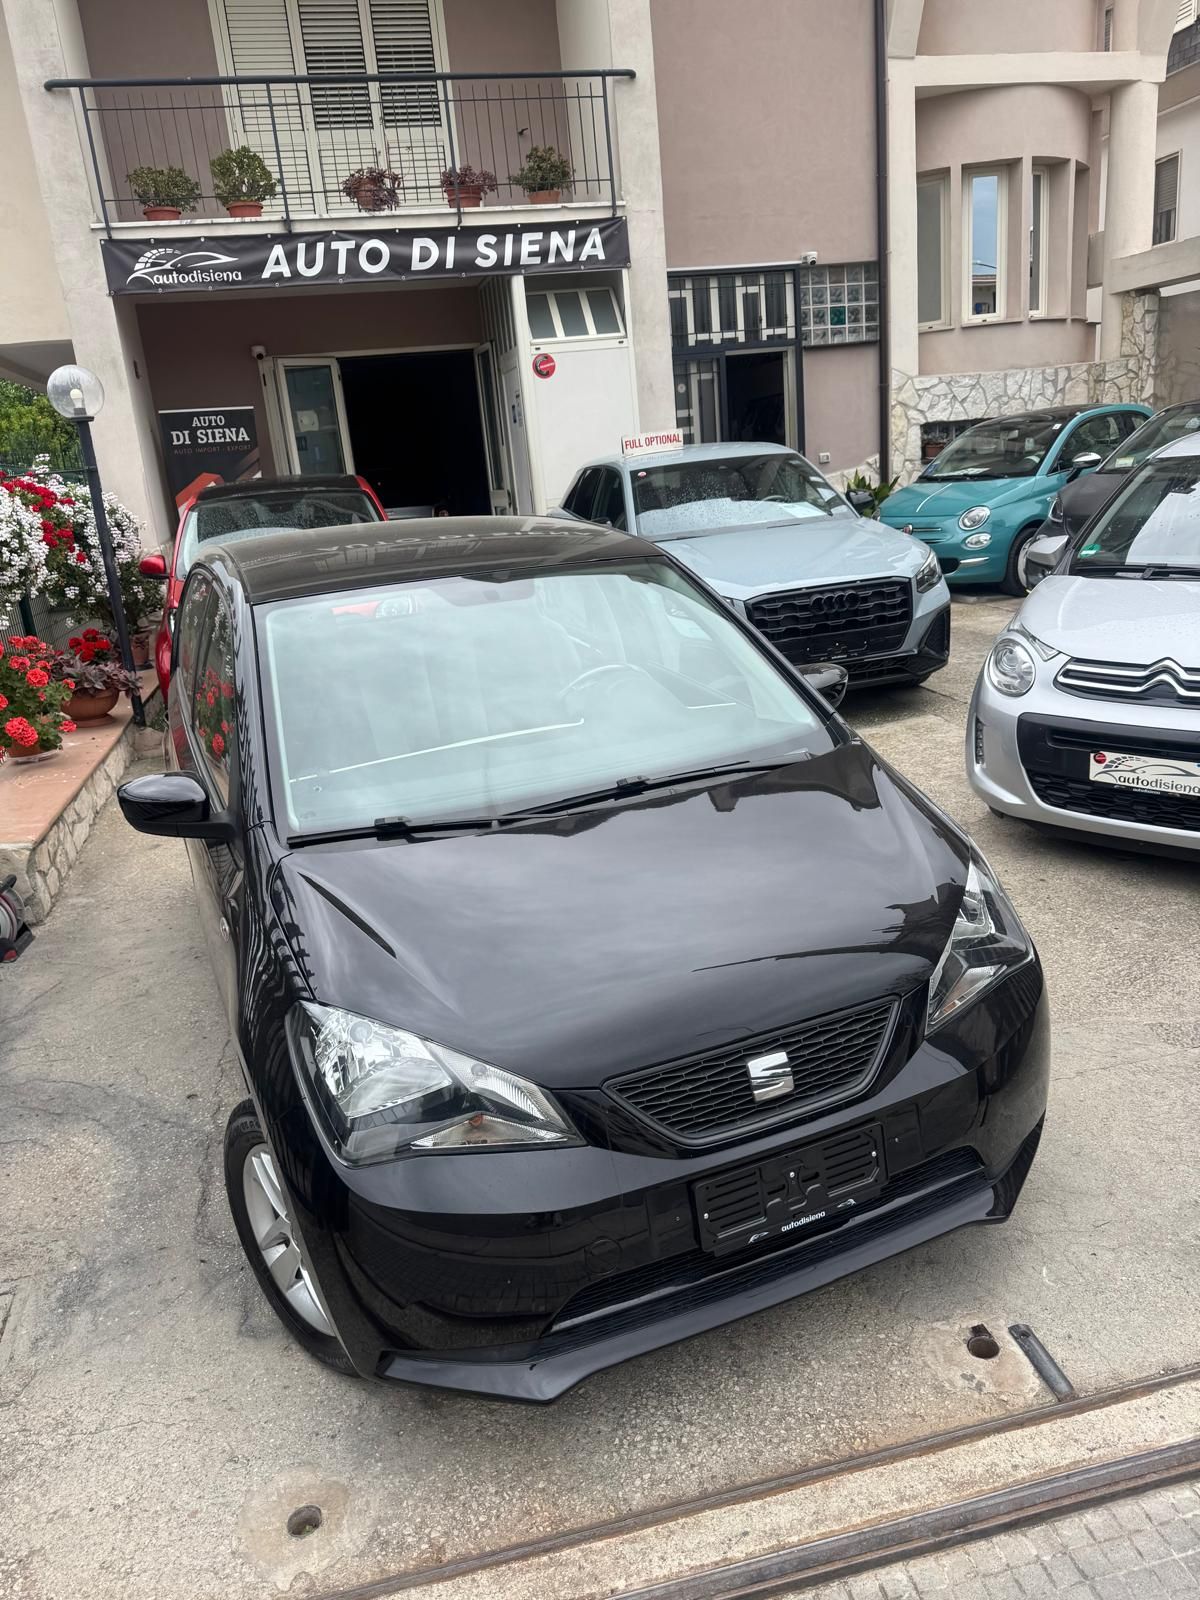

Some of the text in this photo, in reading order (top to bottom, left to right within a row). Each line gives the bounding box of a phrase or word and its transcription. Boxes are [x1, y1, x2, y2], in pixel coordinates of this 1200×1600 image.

[261, 227, 606, 279] AUTO DI SIENA
[153, 269, 242, 284] autodisiena
[192, 415, 225, 427] AUTO
[171, 427, 250, 446] DI SIENA
[625, 434, 682, 450] FULL OPTIONAL
[1118, 775, 1200, 793] autodisiena
[781, 1211, 826, 1232] autodisiena
